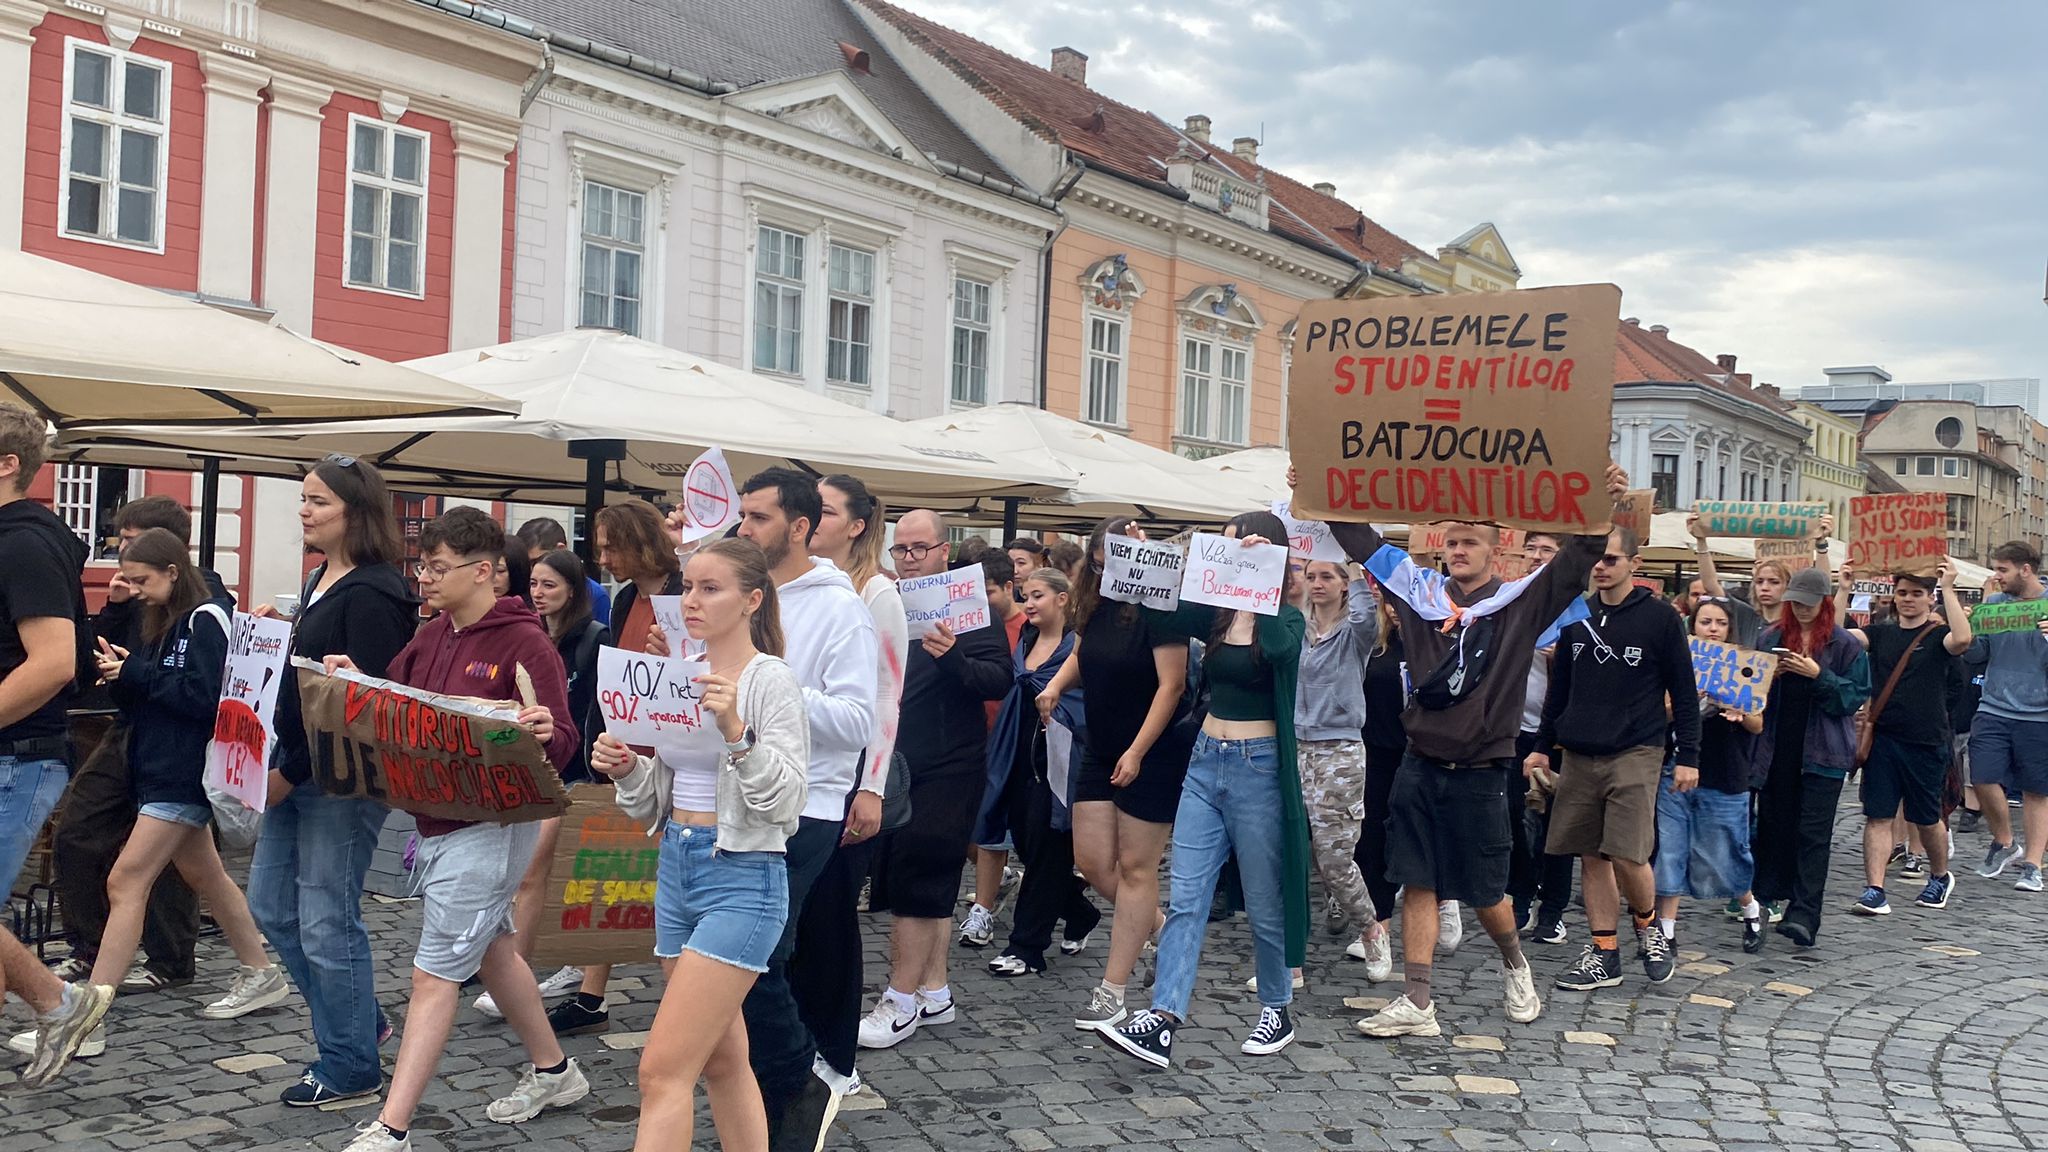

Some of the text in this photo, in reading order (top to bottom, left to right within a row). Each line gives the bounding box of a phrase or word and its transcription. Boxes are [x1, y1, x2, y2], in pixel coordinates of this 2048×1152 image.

[1306, 312, 1568, 352] PROBLEMELE
[1341, 420, 1552, 466] BATJOCURA
[1110, 542, 1131, 559] VREM
[902, 573, 953, 592] GUVERNUL
[1128, 567, 1144, 579] NU
[946, 580, 975, 602] TACE
[622, 659, 665, 700] 10%
[601, 690, 639, 723] 90%
